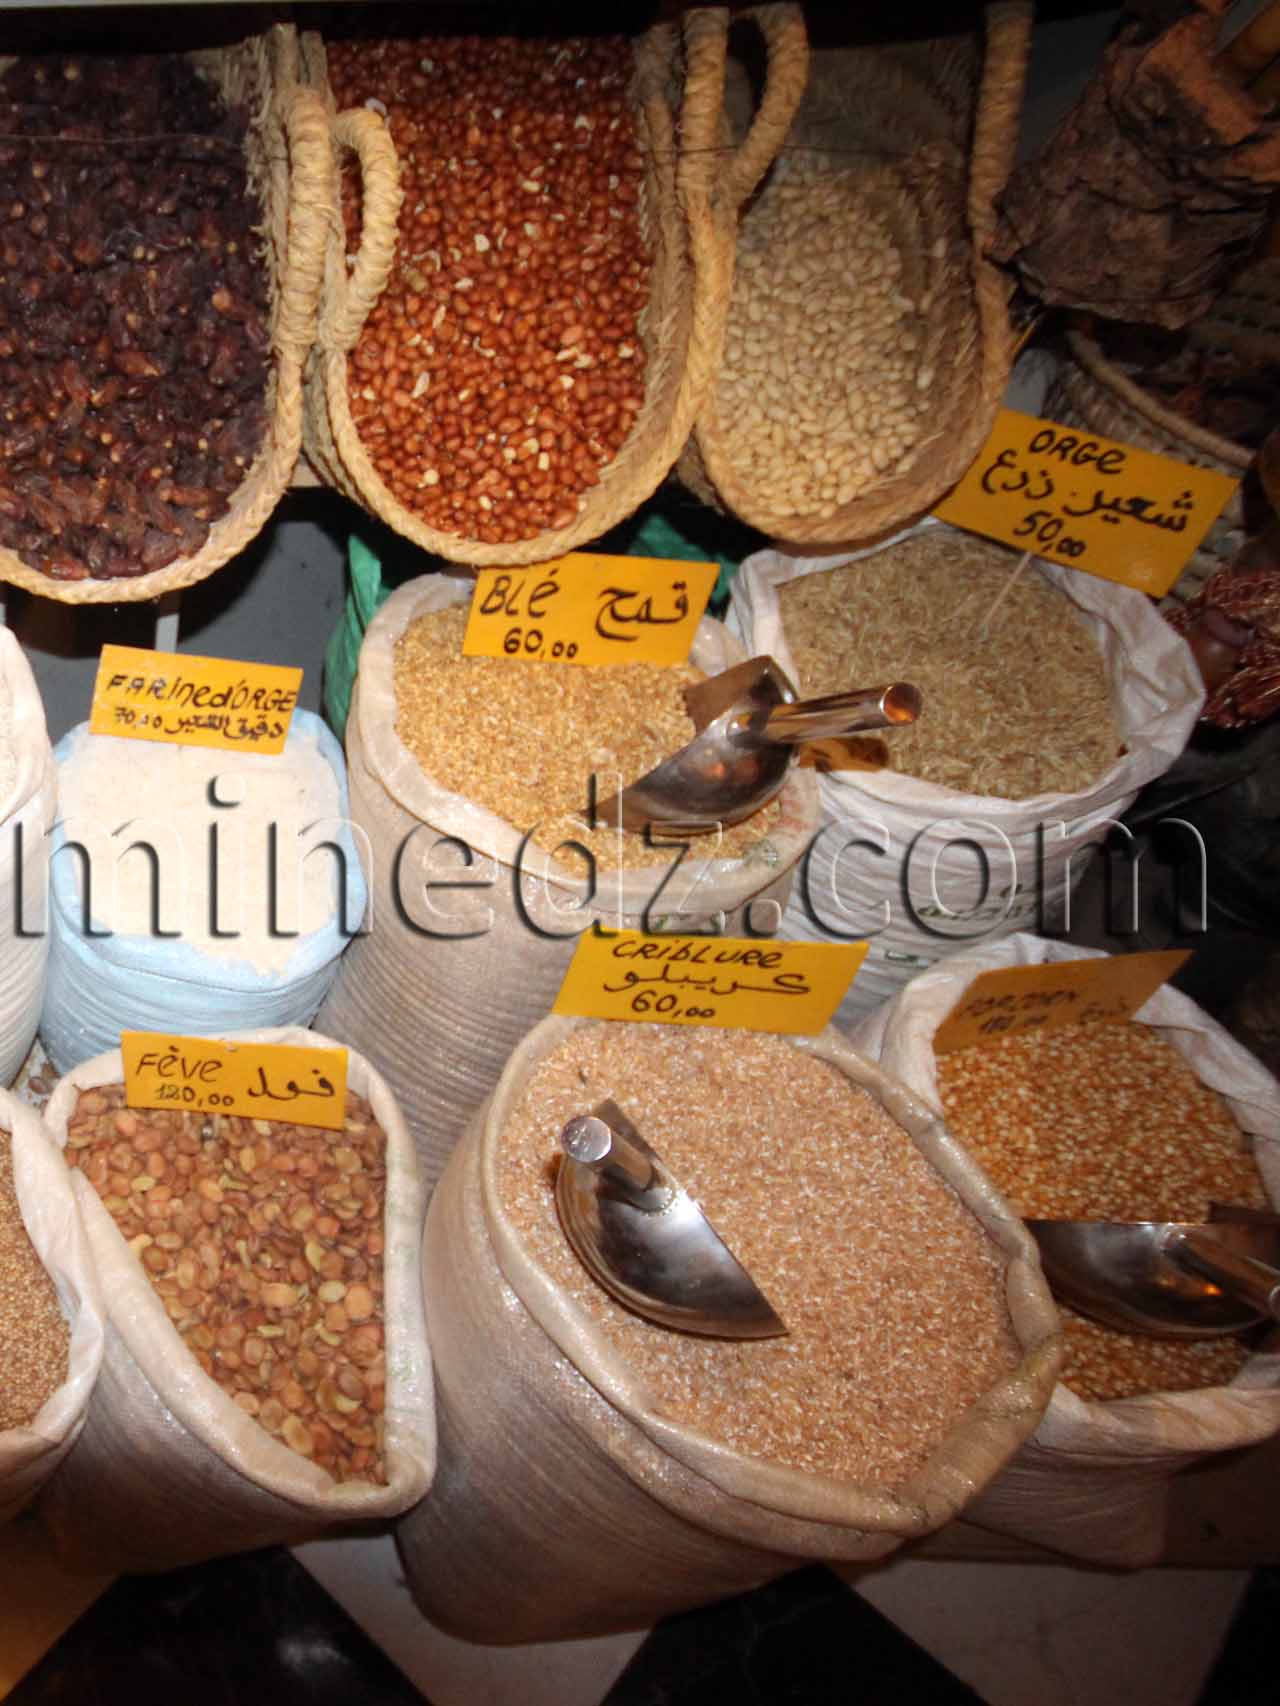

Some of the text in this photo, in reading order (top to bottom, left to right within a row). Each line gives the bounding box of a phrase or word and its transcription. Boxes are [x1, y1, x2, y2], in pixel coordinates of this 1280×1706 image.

[1013, 510, 1087, 558] 50,00
[594, 580, 690, 643] قمح
[503, 626, 580, 660] 60,00
[630, 989, 717, 1020] 60,00
